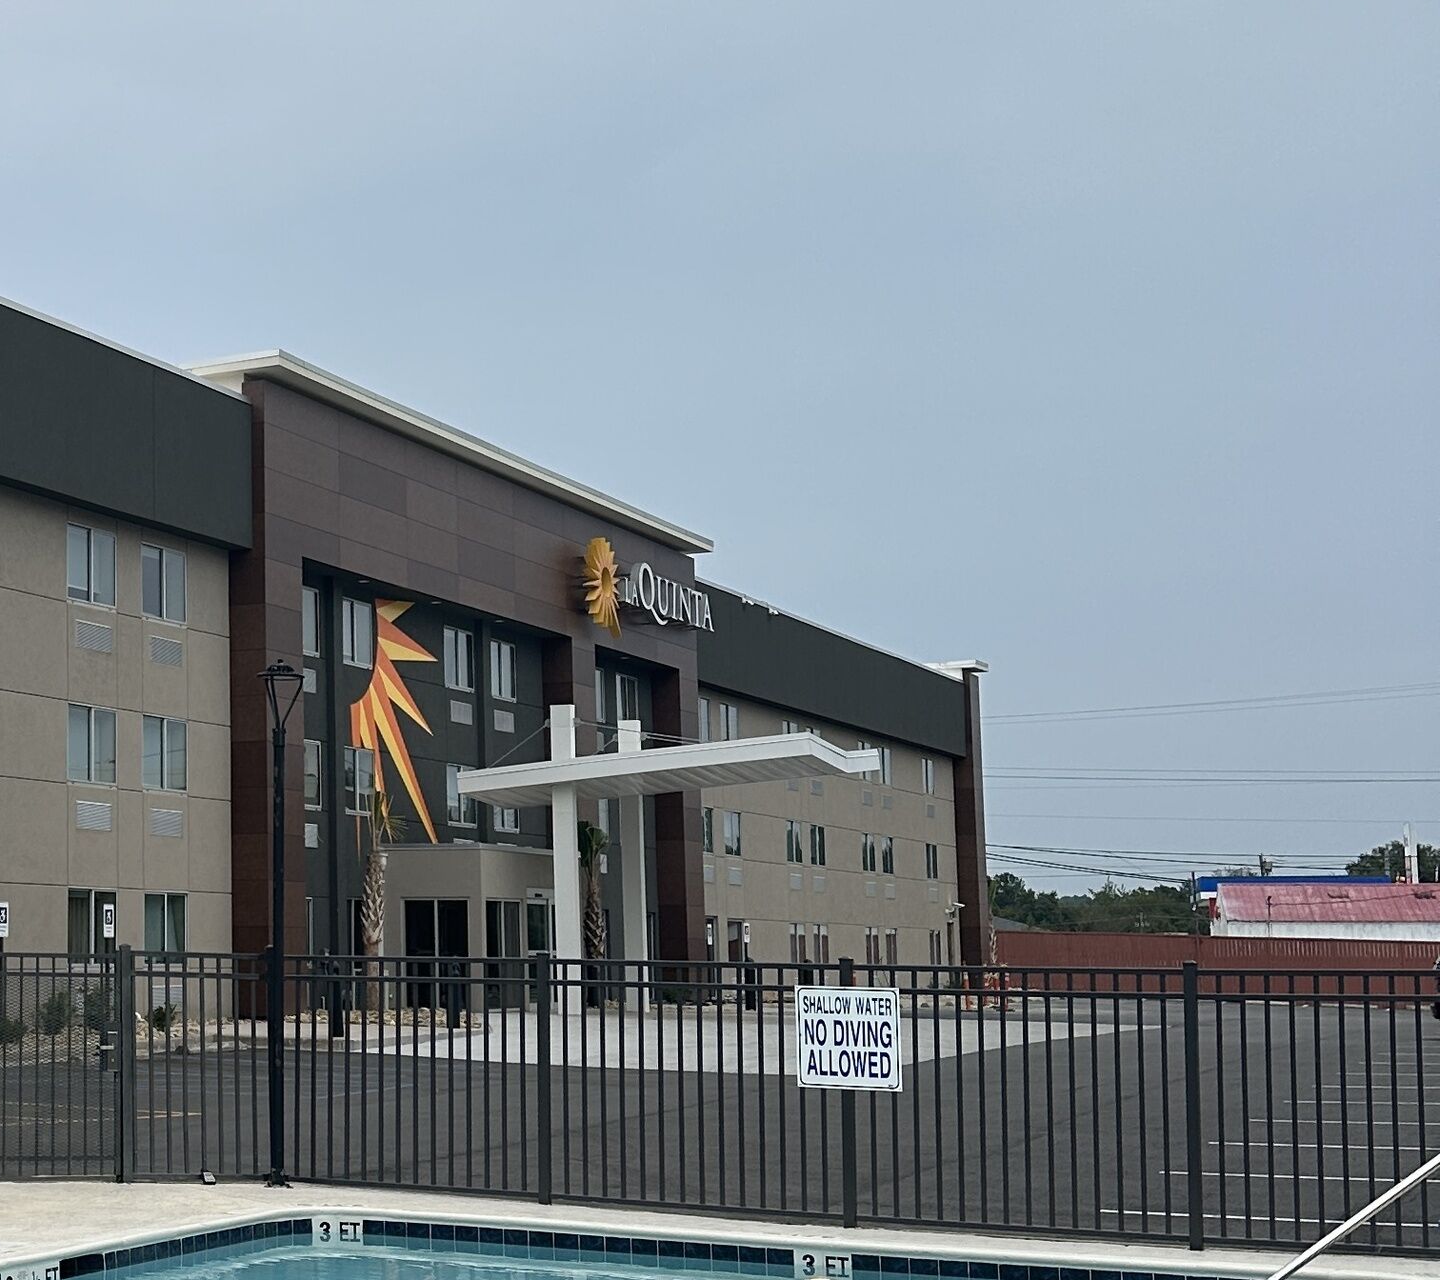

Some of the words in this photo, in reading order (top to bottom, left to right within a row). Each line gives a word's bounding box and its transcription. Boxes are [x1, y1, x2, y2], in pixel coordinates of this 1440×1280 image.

[625, 577, 639, 607] LA
[638, 563, 715, 633] QUINTA
[802, 995, 851, 1015] SHALLOW
[855, 997, 892, 1016] WATER
[804, 1018, 827, 1046] NO
[833, 1020, 892, 1049] DIVING
[807, 1049, 892, 1079] ALLOWED
